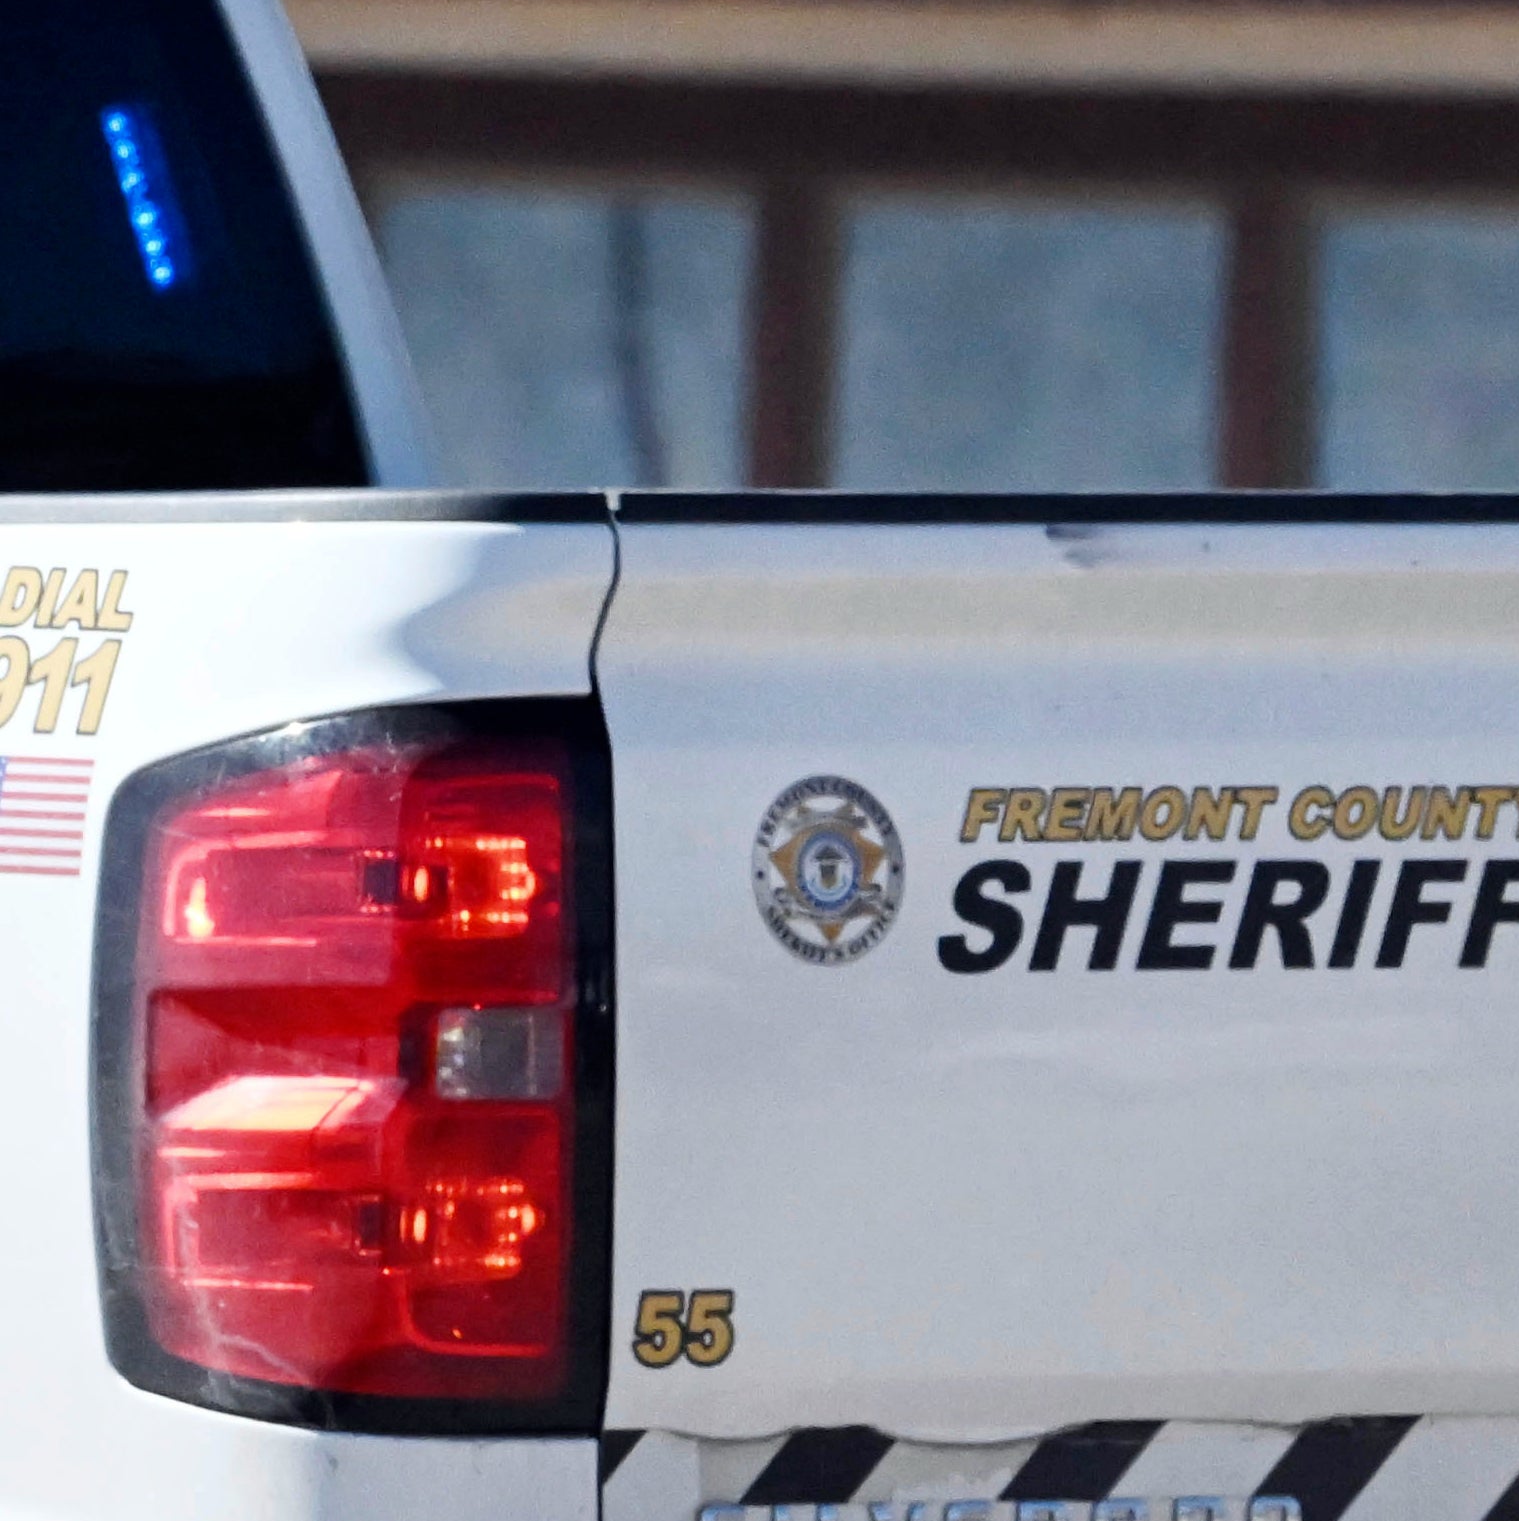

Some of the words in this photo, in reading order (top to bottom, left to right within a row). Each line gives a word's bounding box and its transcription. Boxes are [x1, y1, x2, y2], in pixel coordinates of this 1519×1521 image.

[0, 566, 134, 632] DIAL
[960, 786, 1279, 842] FREMONT
[632, 1289, 734, 1367] 55
